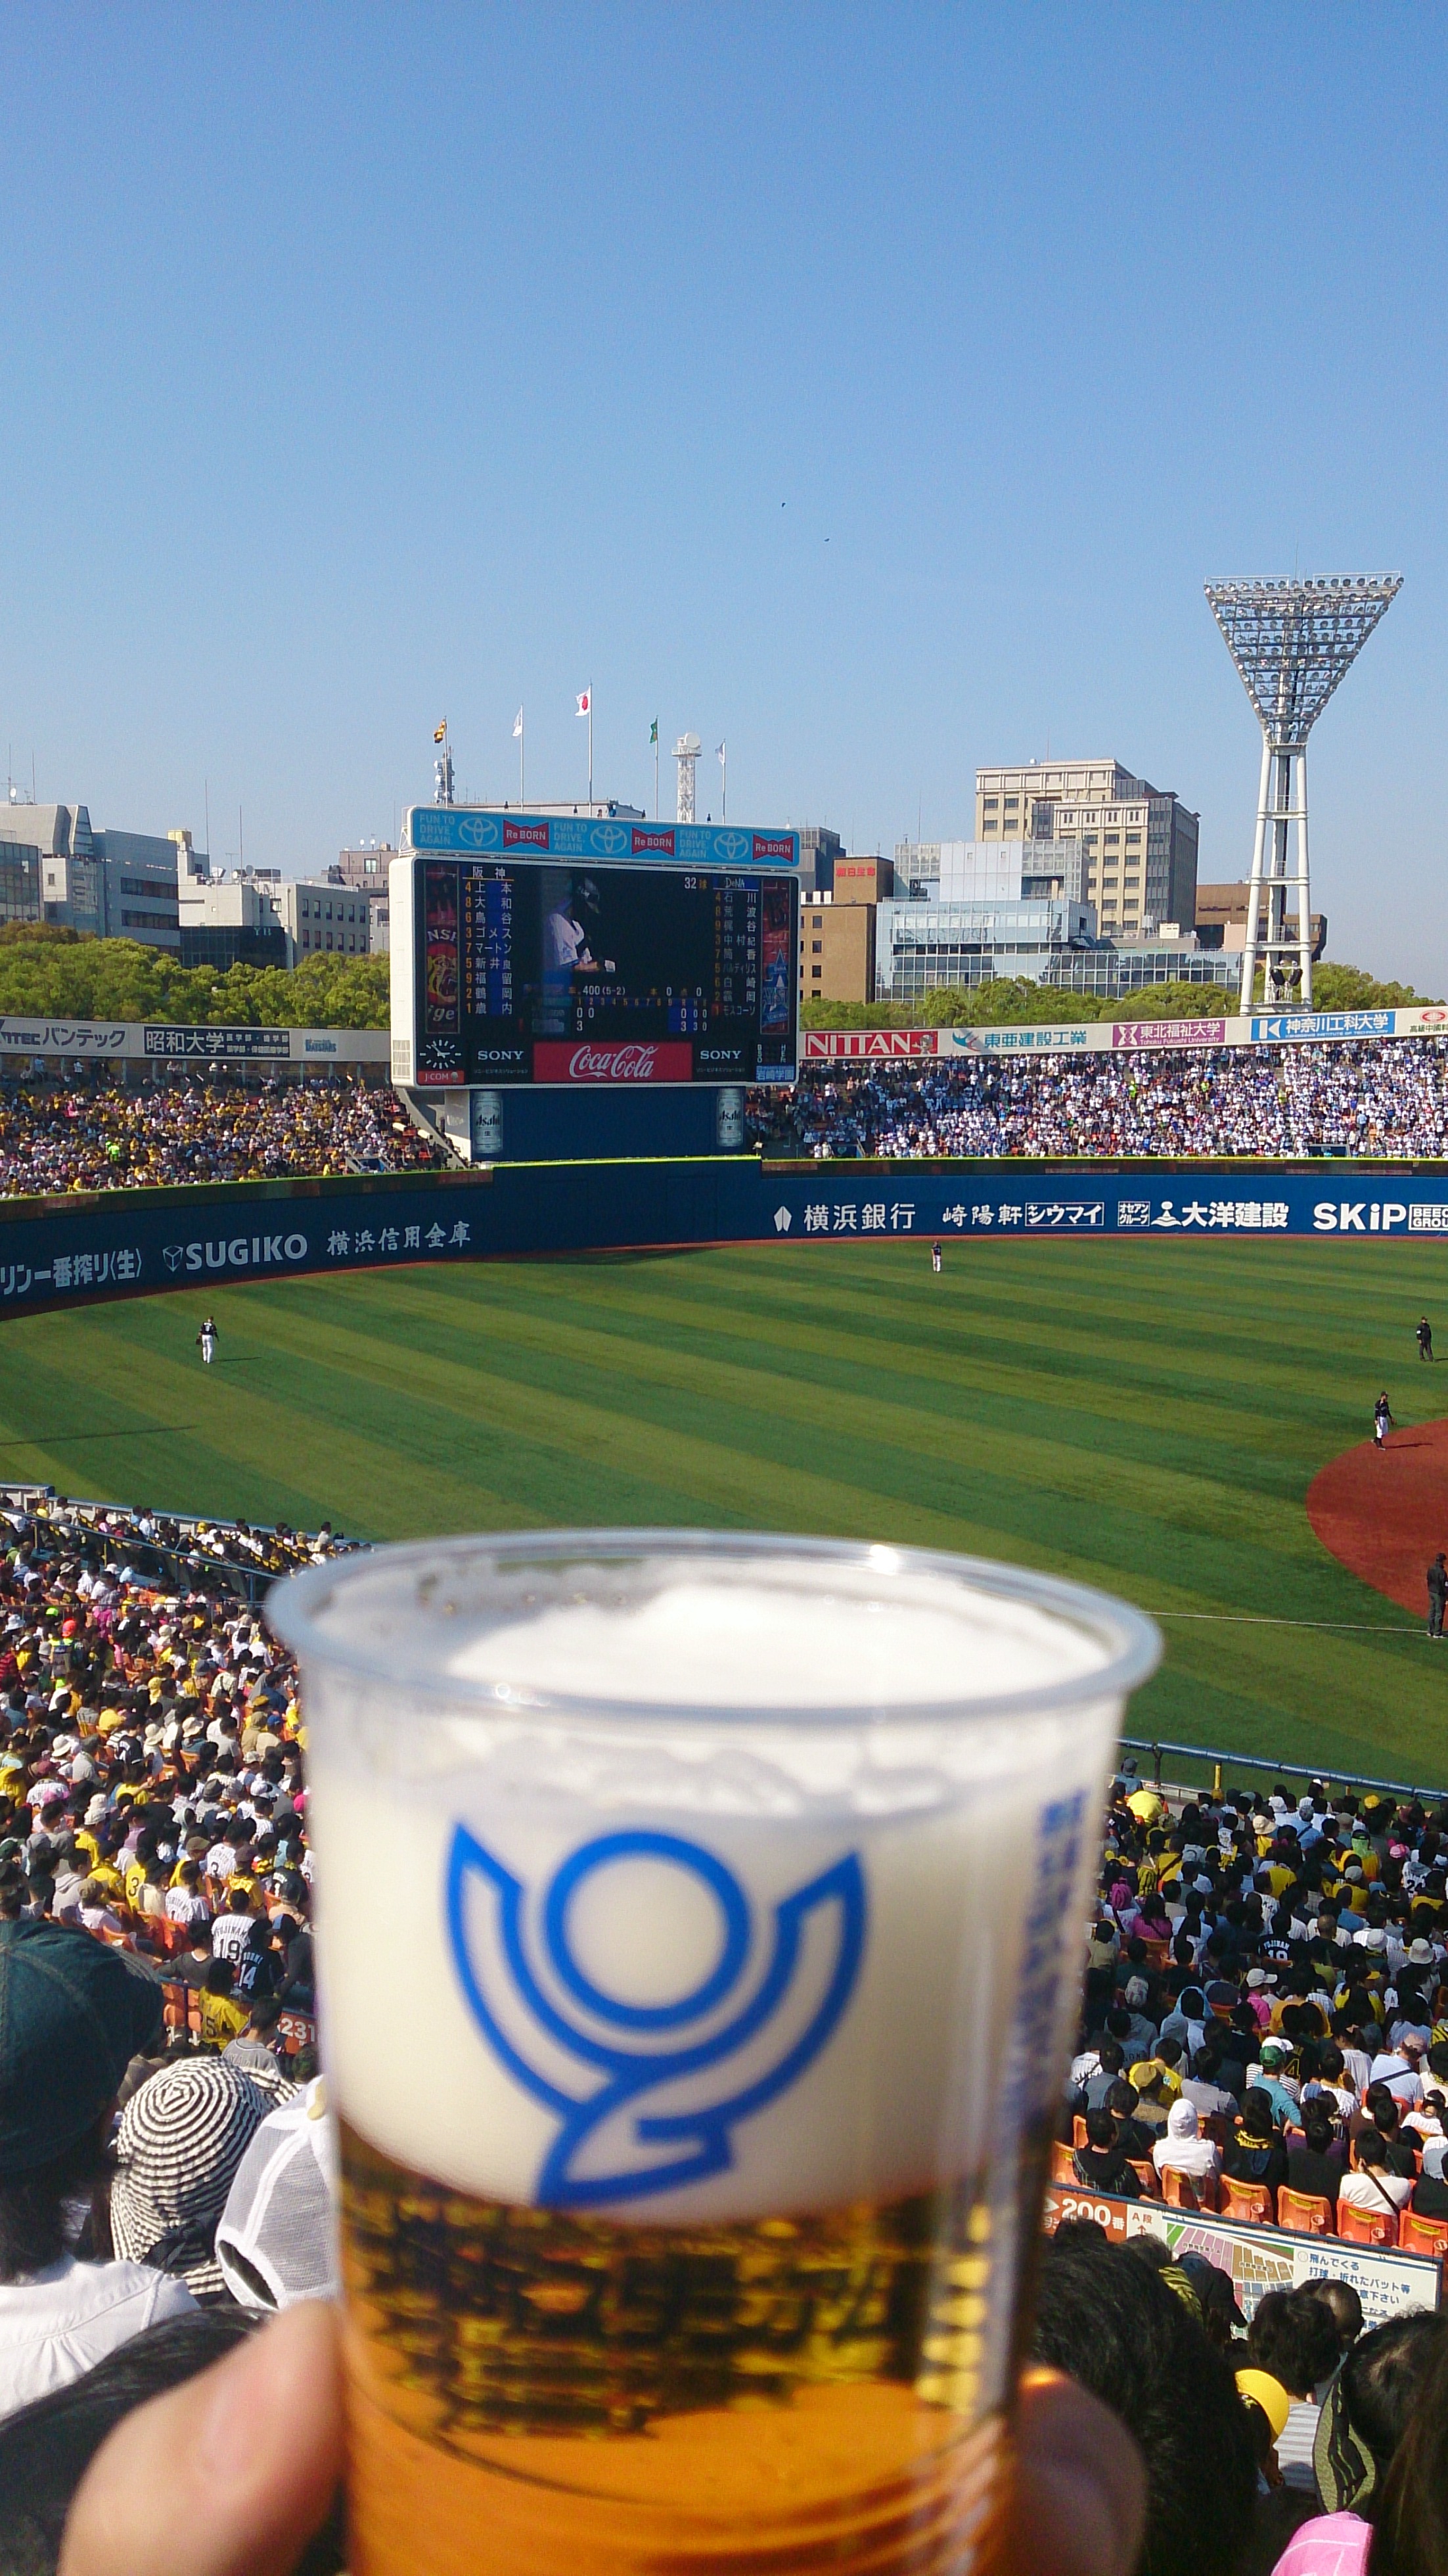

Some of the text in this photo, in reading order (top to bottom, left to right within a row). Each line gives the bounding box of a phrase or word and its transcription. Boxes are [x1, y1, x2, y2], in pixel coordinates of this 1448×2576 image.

[420, 814, 455, 825] FUN TO
[554, 822, 587, 833] FUN TO
[506, 829, 546, 840] Re BORN
[680, 830, 711, 840] FUN TO
[634, 837, 671, 848] Re BORN
[756, 842, 790, 853] Re BORN
[465, 881, 512, 894] 4 上本
[685, 877, 696, 888] 32
[725, 877, 745, 888] DeNA
[465, 896, 512, 909] 8 大和
[723, 892, 756, 903] 石川
[465, 911, 512, 925] 6 鳥谷
[466, 927, 512, 939] 3 ゴメス
[466, 942, 512, 954] 7 マートン
[466, 957, 472, 969] 5
[466, 972, 512, 984] 9 福留
[466, 988, 472, 998] 2
[666, 987, 672, 996] 0
[696, 987, 702, 997] 0
[466, 1003, 471, 1013] 1
[577, 1007, 583, 1018] 0
[588, 1007, 595, 1018] 0
[681, 1008, 687, 1019] 0
[693, 1009, 698, 1018] 0
[702, 1009, 707, 1018] 0
[577, 1021, 707, 1031] 3 3 3 0
[1286, 1014, 1388, 1034] 神奈川工科大学
[1140, 1022, 1221, 1039] 東北福祉大学
[43, 1027, 125, 1048] バンテック
[146, 1030, 225, 1054] 昭和大学
[985, 1030, 1087, 1048] 東亜建設工業
[808, 1034, 911, 1055] NITTAN
[478, 1051, 524, 1061] SONY
[700, 1050, 742, 1059] SONY
[569, 1045, 658, 1078] Coca-Cola
[1028, 1204, 1102, 1224] シウマイ
[1119, 1203, 1149, 1213] オセアン
[803, 1203, 916, 1231] 横浜銀行
[942, 1204, 1023, 1227] 崎陽軒
[1119, 1214, 1149, 1225] グループ
[1181, 1201, 1289, 1228] 大洋建設
[327, 1221, 471, 1256] 横浜信用金庫
[186, 1233, 307, 1270] SUGIKO
[128, 1877, 139, 1897] 3
[219, 1939, 241, 1961] 19
[238, 1964, 257, 1990] 14
[281, 2017, 315, 2042] 231
[1309, 2253, 1359, 2271] 飛んでくる
